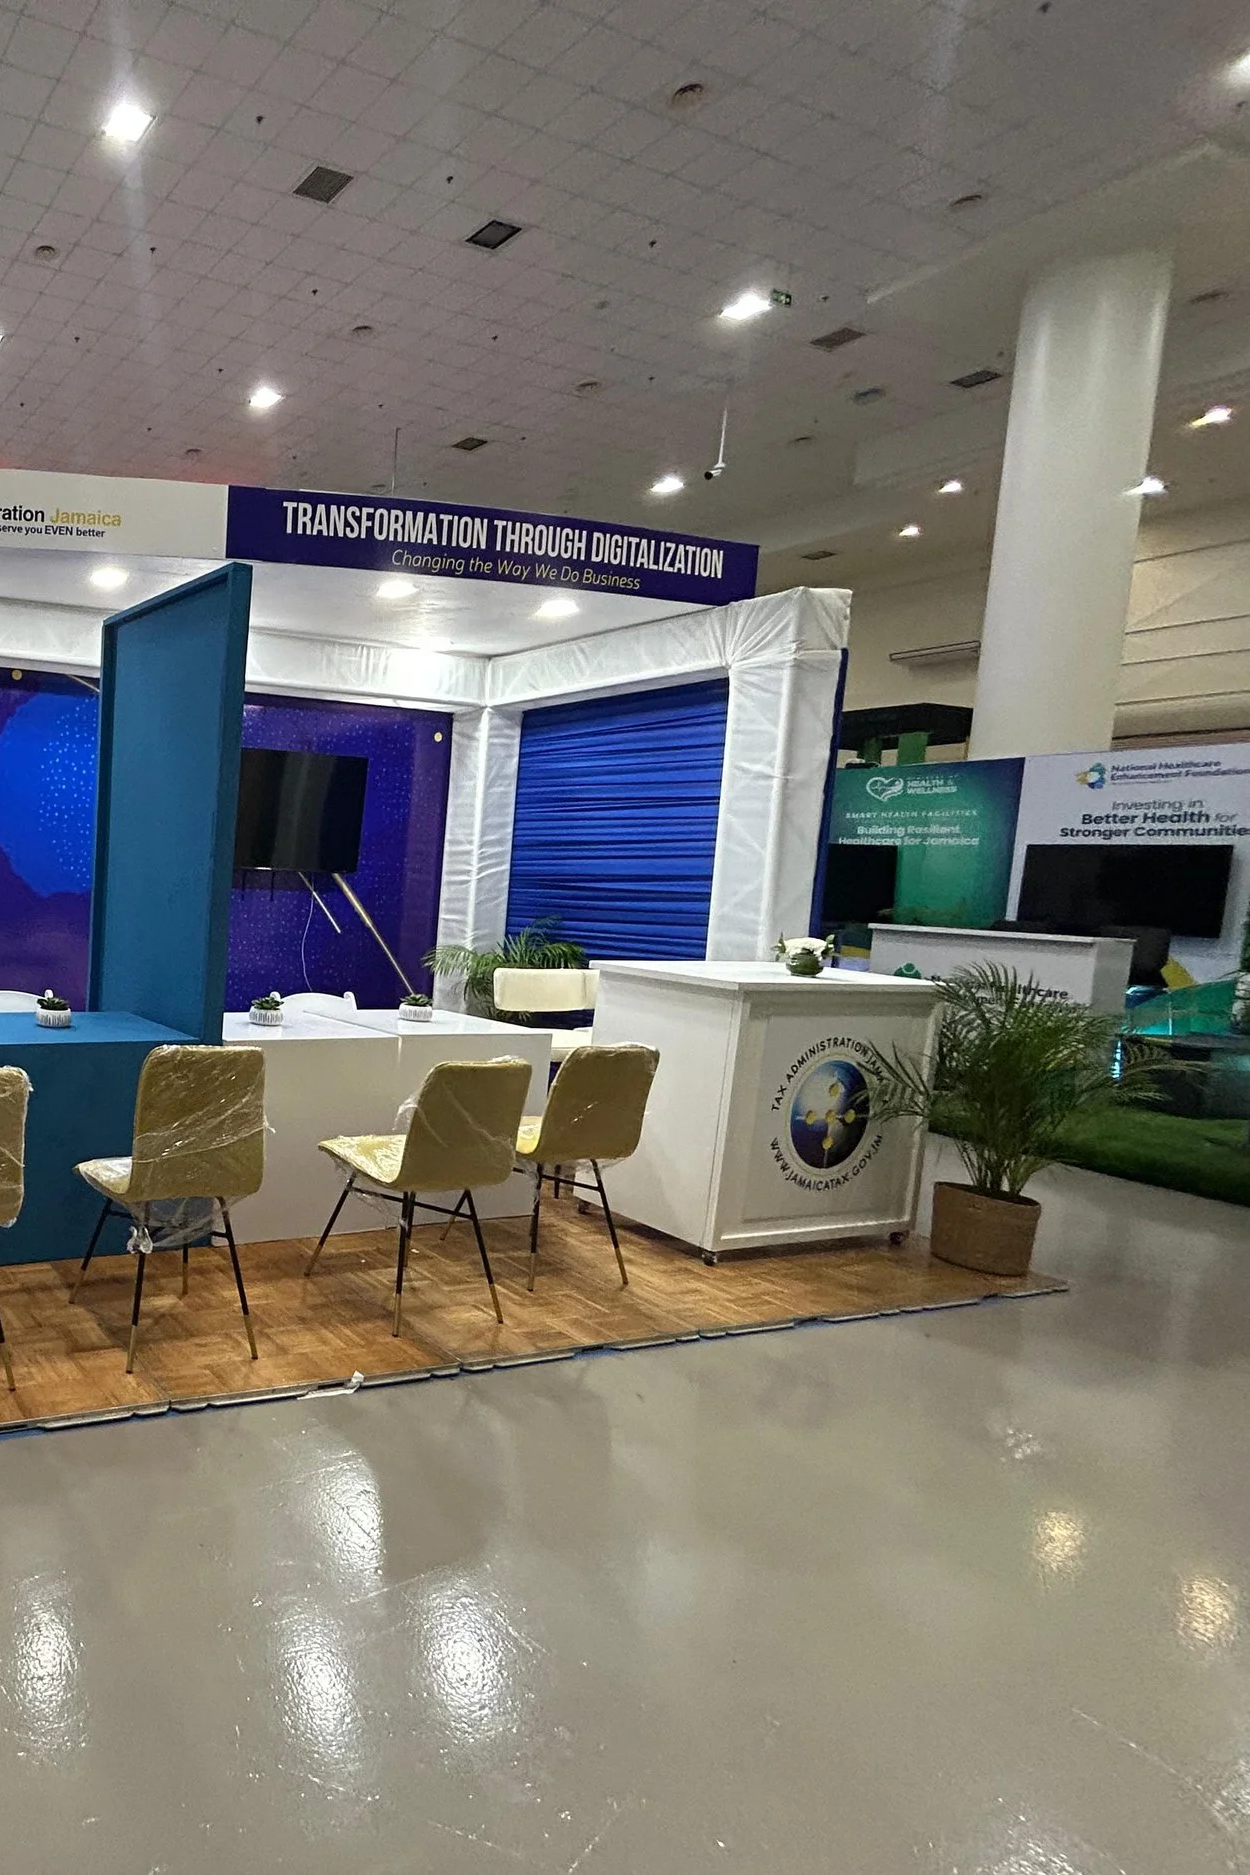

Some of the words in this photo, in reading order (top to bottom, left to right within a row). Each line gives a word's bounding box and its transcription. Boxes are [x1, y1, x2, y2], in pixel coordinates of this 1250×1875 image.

[50, 508, 122, 526] Jamaica
[25, 526, 43, 535] you
[44, 525, 73, 535] EVEN
[76, 527, 106, 537] better
[283, 501, 488, 549] TRANSFORMATION
[494, 520, 587, 561] THROUGH
[591, 531, 724, 579] DIGITALIZATION
[392, 550, 465, 575] Changing
[469, 557, 493, 574] the
[497, 559, 531, 581] Way
[535, 563, 558, 580] We
[561, 566, 580, 582] Do
[583, 568, 641, 590] Business
[1112, 800, 1183, 812] Investing
[1188, 800, 1203, 809] in
[1082, 813, 1138, 825] Better
[1143, 811, 1210, 824] Health
[1214, 812, 1238, 823] for
[857, 825, 905, 837] Building
[907, 825, 961, 834] Resilient
[1060, 827, 1130, 841] Stronger
[903, 836, 924, 846] for
[772, 1084, 787, 1112] TAX
[785, 1036, 870, 1084] ADMINISTRATION
